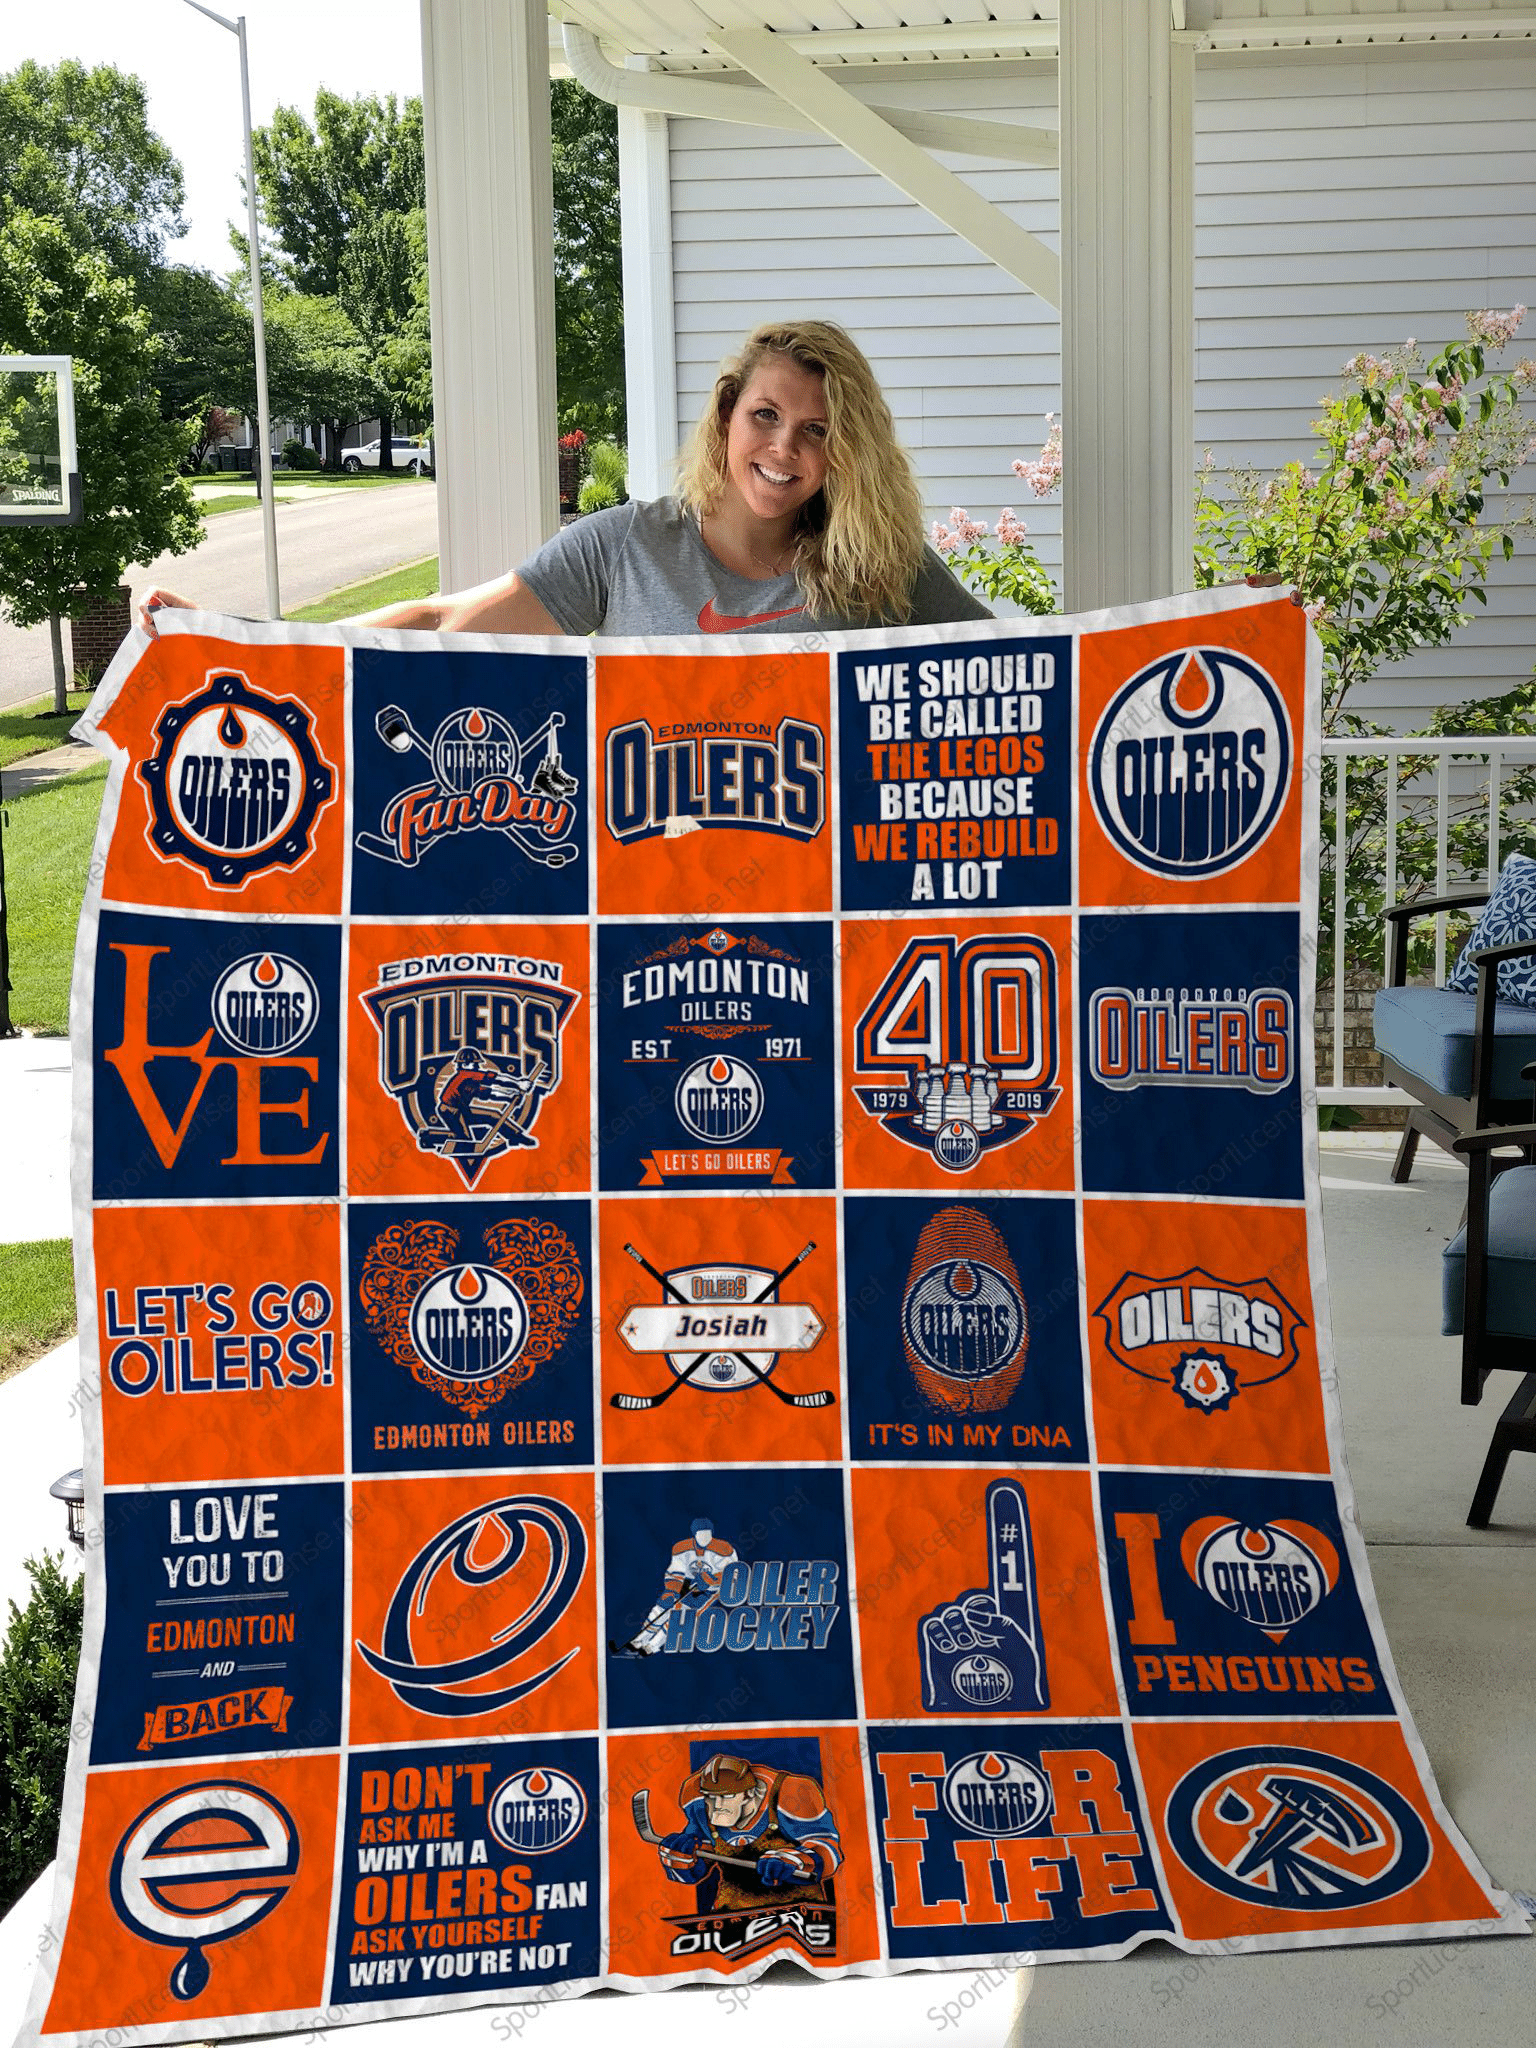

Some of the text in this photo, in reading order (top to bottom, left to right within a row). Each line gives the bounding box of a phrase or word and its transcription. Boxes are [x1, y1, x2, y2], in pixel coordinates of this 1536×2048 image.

[12, 489, 60, 501] SPALDING
[854, 653, 1055, 702] WE SHOULD
[658, 721, 772, 738] EDMONTON
[869, 694, 1043, 741] BE CALLED
[605, 716, 826, 842] OILERS
[866, 734, 1045, 781] THE LEGOS
[388, 780, 568, 859] Fan Day
[880, 776, 1034, 821] BECAUSE
[852, 817, 1059, 862] WE REBUILD
[911, 860, 1003, 901] A LOT
[381, 955, 560, 982] EDMONTON
[622, 958, 810, 1009] EDMONTON
[681, 1000, 752, 1023] OILERS
[854, 933, 1059, 1090] 40
[384, 990, 558, 1092] OILERS
[631, 1039, 672, 1060] EST
[765, 1038, 802, 1058] 1971
[1092, 990, 1293, 1088] OILERS
[872, 1093, 908, 1109] 1979
[1006, 1093, 1042, 1109] 2019
[664, 1153, 771, 1171] LET'S GO OILERS
[105, 1280, 333, 1338] LET'S GO
[692, 1275, 746, 1299] OILERS
[676, 1315, 767, 1337] Josiah
[1119, 1286, 1285, 1359] OILERS
[109, 1332, 334, 1398] OILERS!
[373, 1420, 575, 1451] EDMONTON OILERS
[868, 1424, 1072, 1448] IT'S IN MY DNA
[170, 1493, 279, 1544] LOVE
[1000, 1523, 1018, 1543] #
[162, 1550, 284, 1588] YOU TO
[718, 1560, 840, 1607] OILER
[1000, 1550, 1024, 1592] 1
[1113, 1512, 1177, 1645] I
[146, 1612, 295, 1653] EDMONTON
[663, 1606, 840, 1653] HOCKEY
[200, 1661, 235, 1678] AND
[1132, 1655, 1376, 1693] PENGUINS
[164, 1690, 268, 1739] BACK
[360, 1762, 492, 1814] DON'T
[359, 1812, 455, 1844] ASK ME
[358, 1839, 488, 1873] WHY I'M A
[353, 1864, 587, 1926] OILERS FAN
[884, 1833, 1158, 1928] LIFE
[350, 1915, 544, 1956] ASK YOURSELF
[672, 1911, 830, 1955] OILERS
[349, 1942, 573, 1988] WHY YOU'RE NOT
